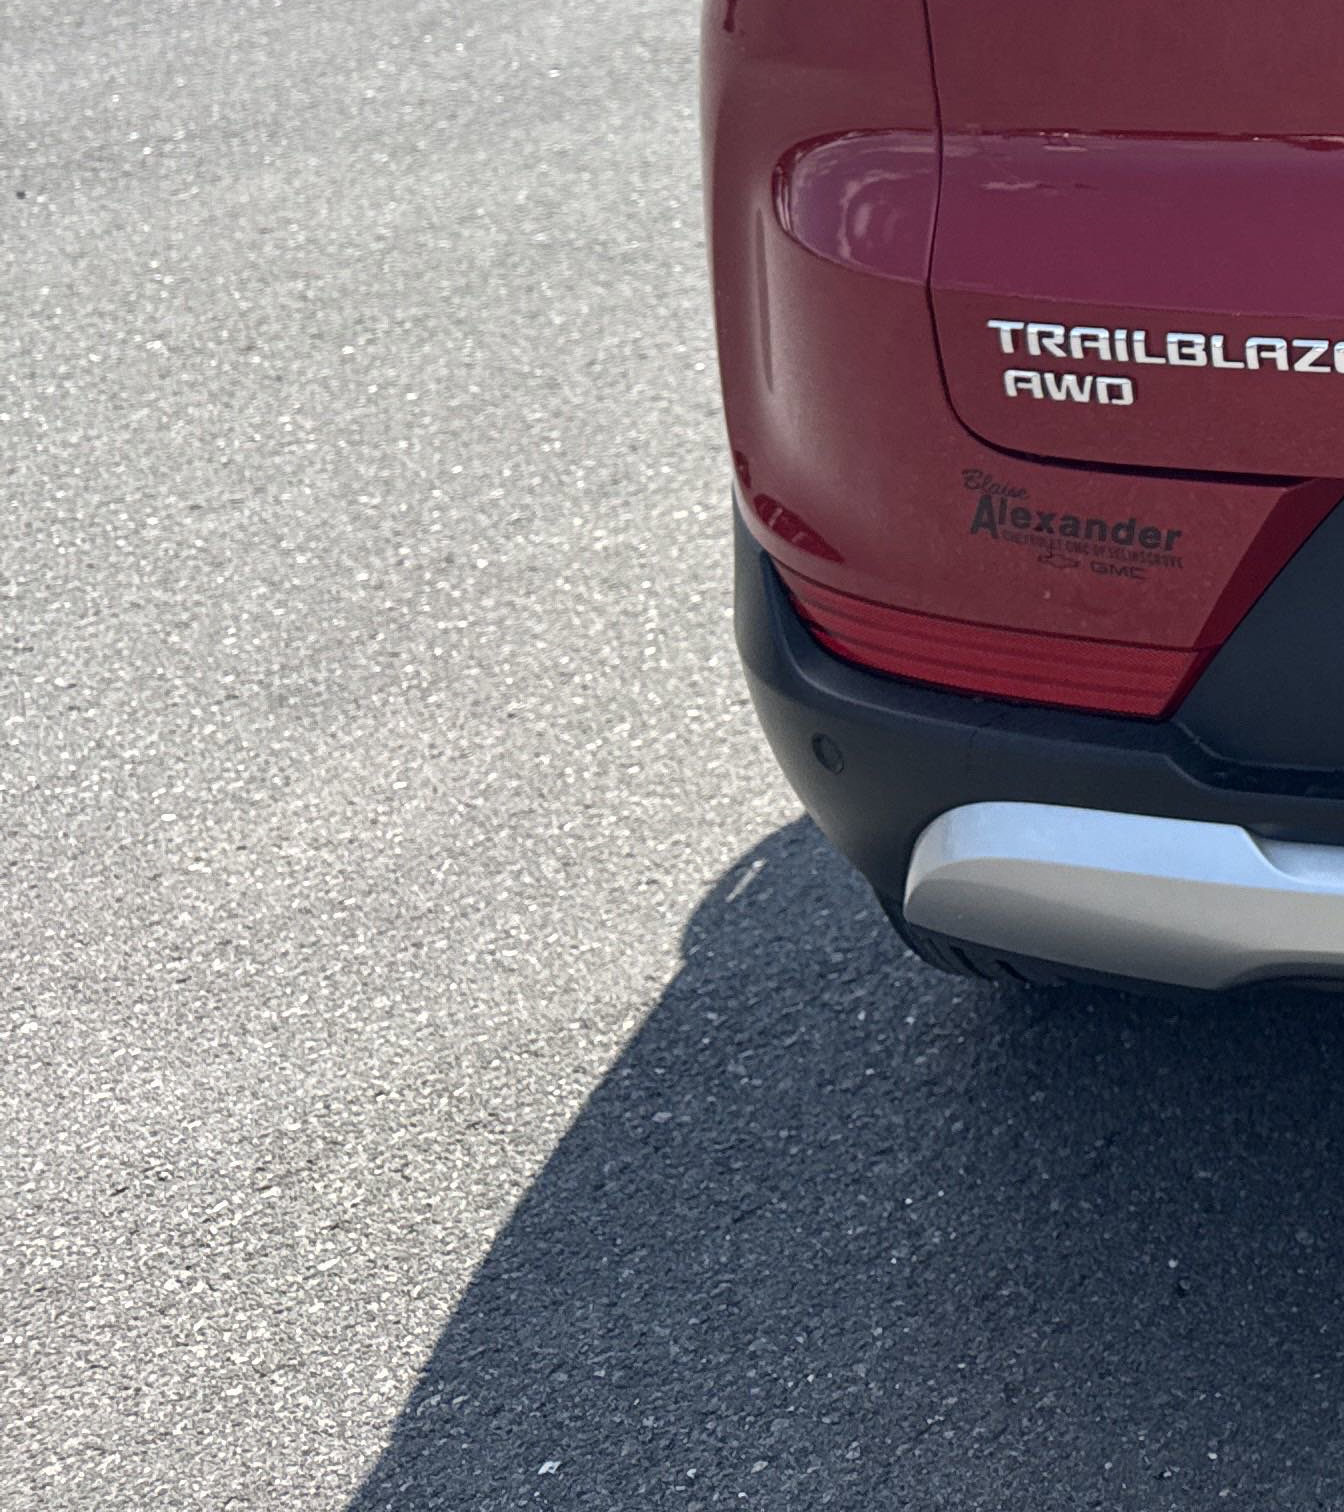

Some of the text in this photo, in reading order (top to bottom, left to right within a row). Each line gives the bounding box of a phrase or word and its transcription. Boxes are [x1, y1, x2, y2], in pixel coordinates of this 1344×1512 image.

[1003, 369, 1135, 406] AWD
[970, 494, 1183, 551] Alexander
[1090, 561, 1152, 580] GMC
